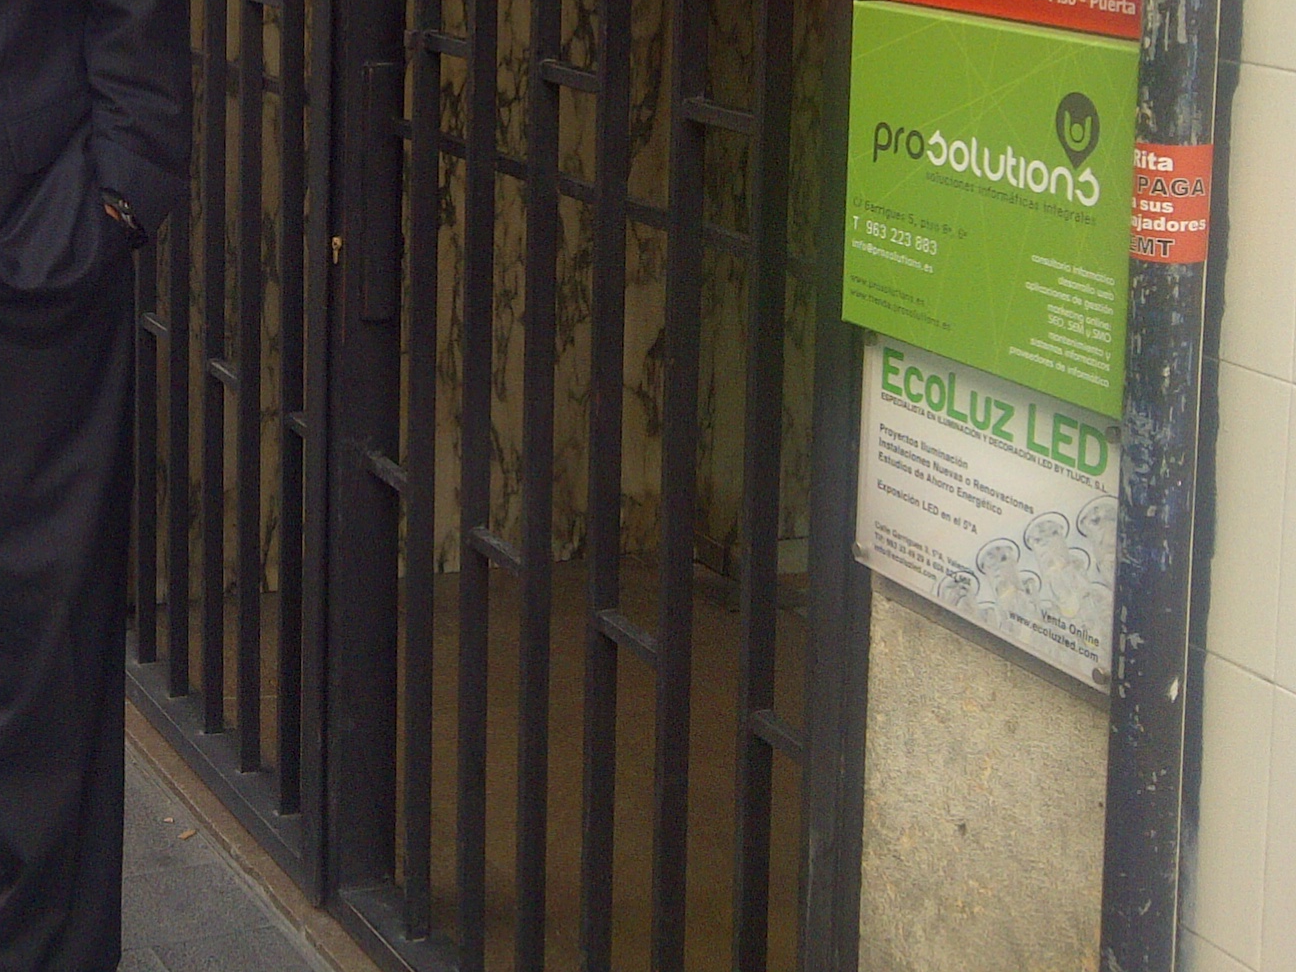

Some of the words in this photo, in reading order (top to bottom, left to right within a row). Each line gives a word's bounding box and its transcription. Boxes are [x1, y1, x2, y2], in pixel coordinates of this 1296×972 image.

[873, 122, 1100, 206] prosolutions
[1137, 175, 1205, 197] PAGA
[1140, 197, 1173, 214] sus
[866, 219, 887, 239] 963
[890, 228, 912, 247] 223
[879, 422, 919, 448] Proyectos
[921, 440, 969, 470] Iluminación
[1026, 402, 1109, 477] LED
[878, 450, 913, 475] Estudios
[914, 468, 924, 480] de
[926, 473, 955, 493] Ahorro
[956, 486, 1003, 516] Energético
[1037, 457, 1053, 470] LED
[877, 478, 920, 507] Exposición
[922, 500, 939, 516] LED
[940, 511, 951, 522] en
[932, 460, 963, 482] Nuevas
[973, 478, 1034, 515] Renovaciones
[1008, 611, 1099, 664] www.ecoluzled.com
[1040, 608, 1067, 630] Venta
[1069, 623, 1100, 647] Online
